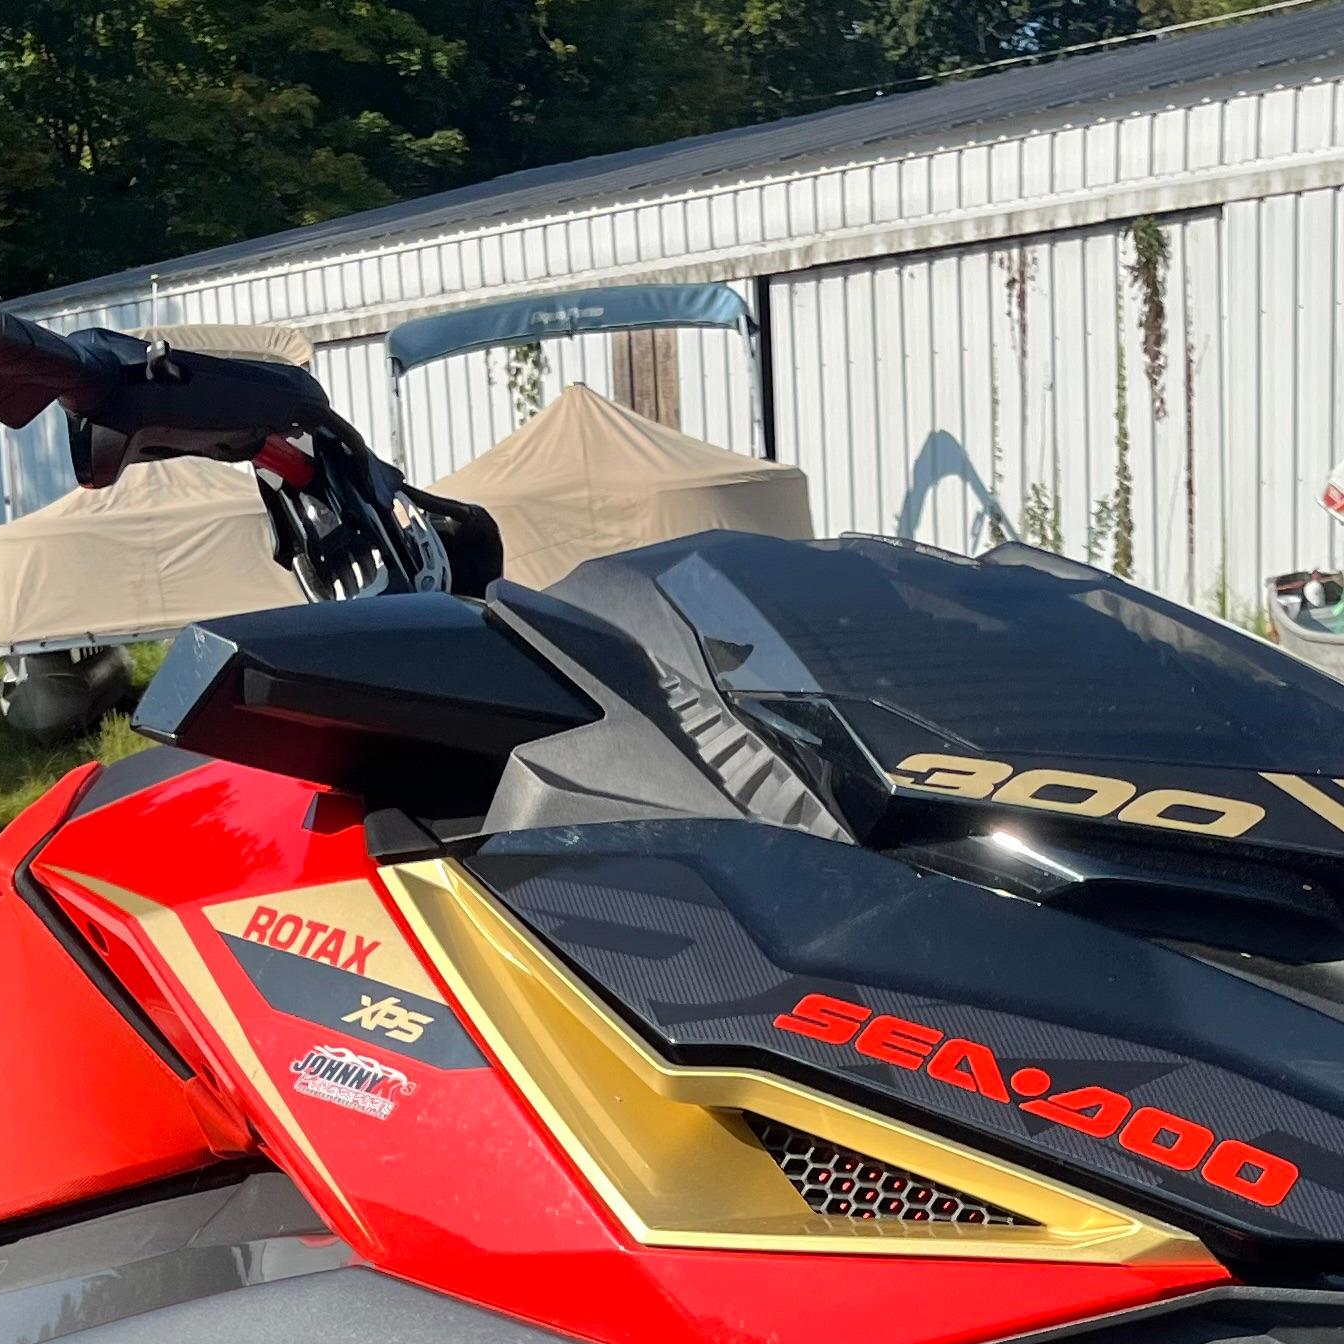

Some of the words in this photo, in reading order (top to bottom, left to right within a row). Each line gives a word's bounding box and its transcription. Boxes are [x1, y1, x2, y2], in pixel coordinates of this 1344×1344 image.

[889, 753, 1266, 838] 300
[243, 905, 381, 976] ROTAX
[341, 994, 434, 1043] XPS
